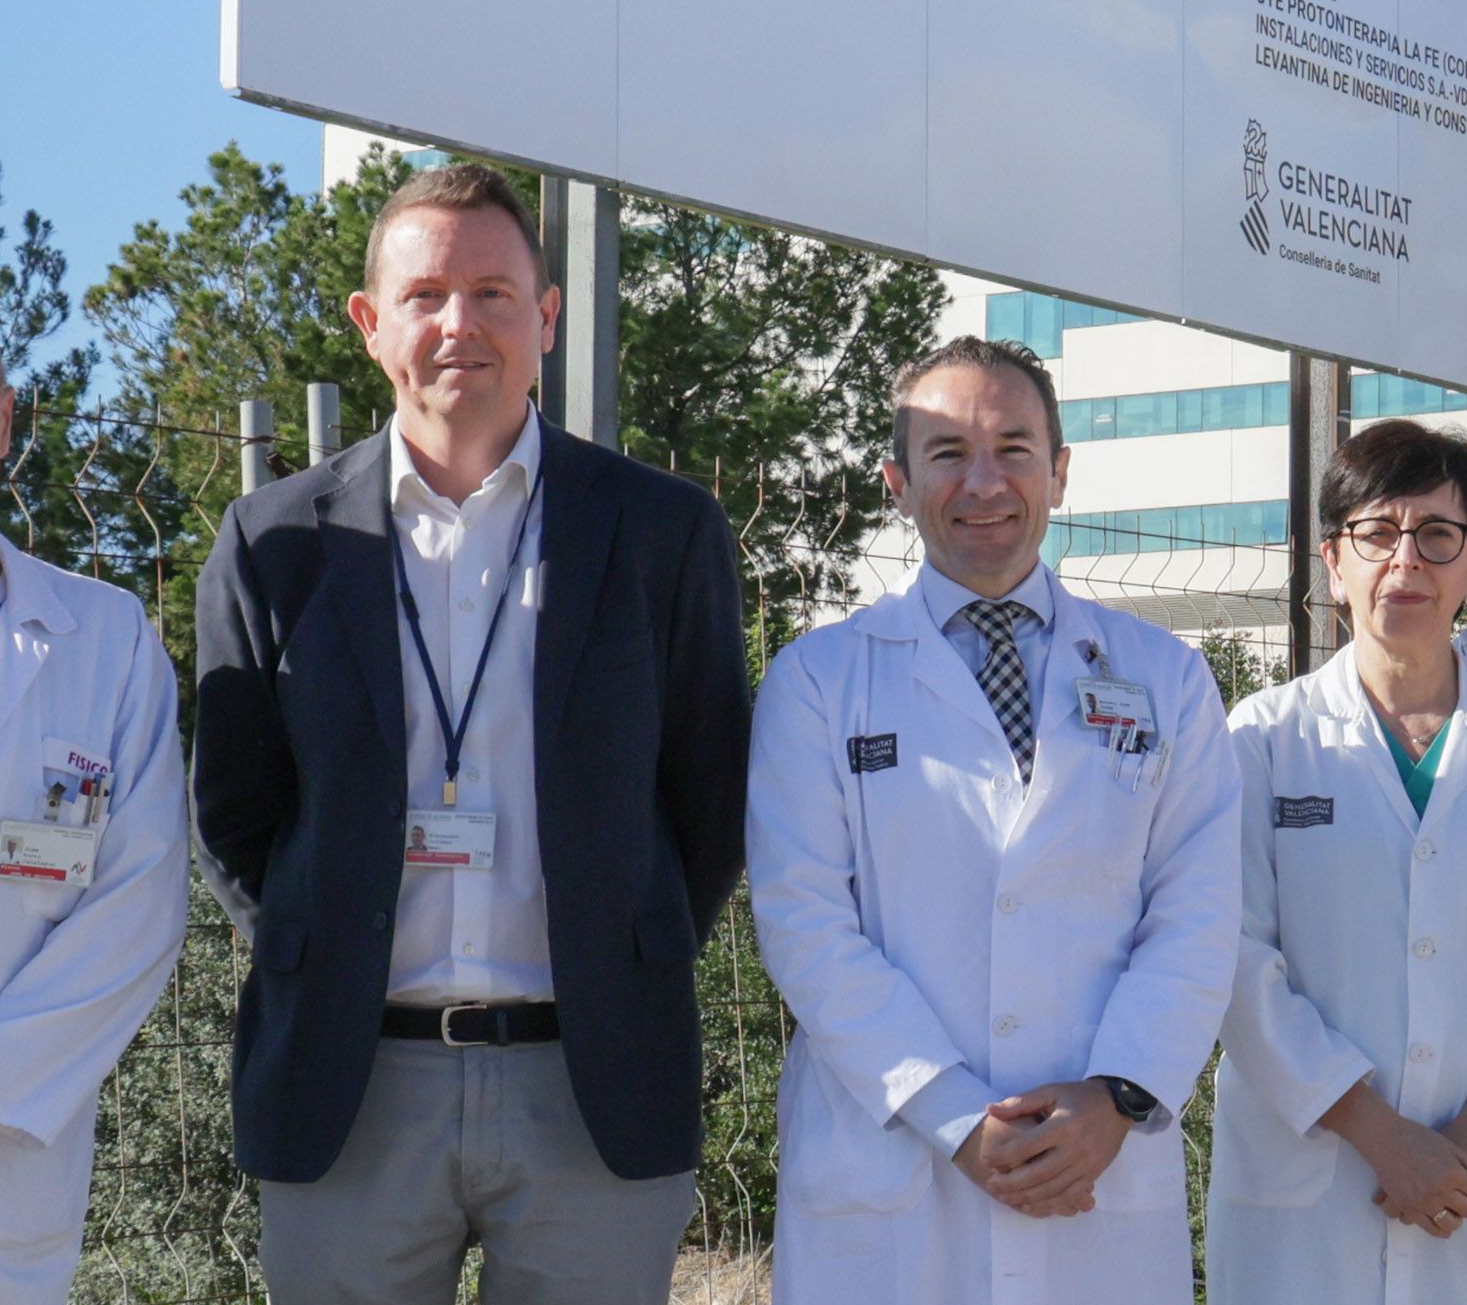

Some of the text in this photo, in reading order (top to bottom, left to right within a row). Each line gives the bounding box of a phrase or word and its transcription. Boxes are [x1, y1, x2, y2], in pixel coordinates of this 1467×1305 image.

[1255, 12, 1353, 67] INSTALACIONES
[1355, 48, 1364, 70] Y
[1365, 53, 1426, 92] SERVICIOS
[1255, 43, 1330, 88] LEVANTINA
[1332, 70, 1350, 94] DE
[1351, 76, 1421, 120] INGENIERIA
[1423, 101, 1433, 123] Y
[1403, 38, 1422, 63] LA
[1424, 45, 1440, 69] FE
[1278, 160, 1413, 226] GENERALITAT
[1278, 243, 1382, 285] Conselleria de Sanitat
[1279, 198, 1411, 264] VALENCIANA
